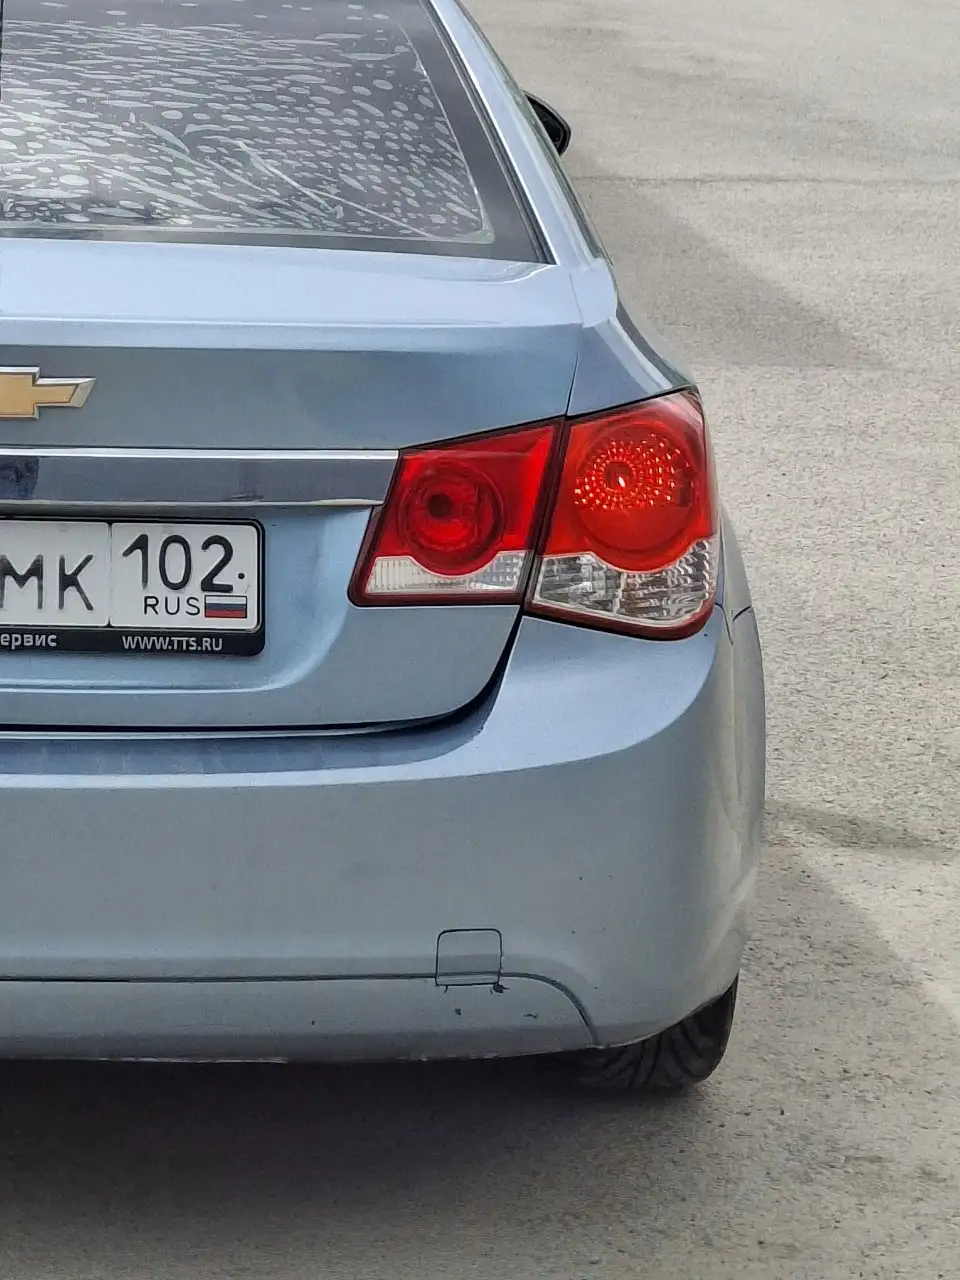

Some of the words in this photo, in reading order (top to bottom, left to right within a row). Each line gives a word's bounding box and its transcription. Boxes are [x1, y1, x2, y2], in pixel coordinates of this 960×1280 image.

[122, 533, 234, 593] 102
[143, 595, 200, 616] RUS
[122, 635, 224, 651] WWW.TTS.RU
